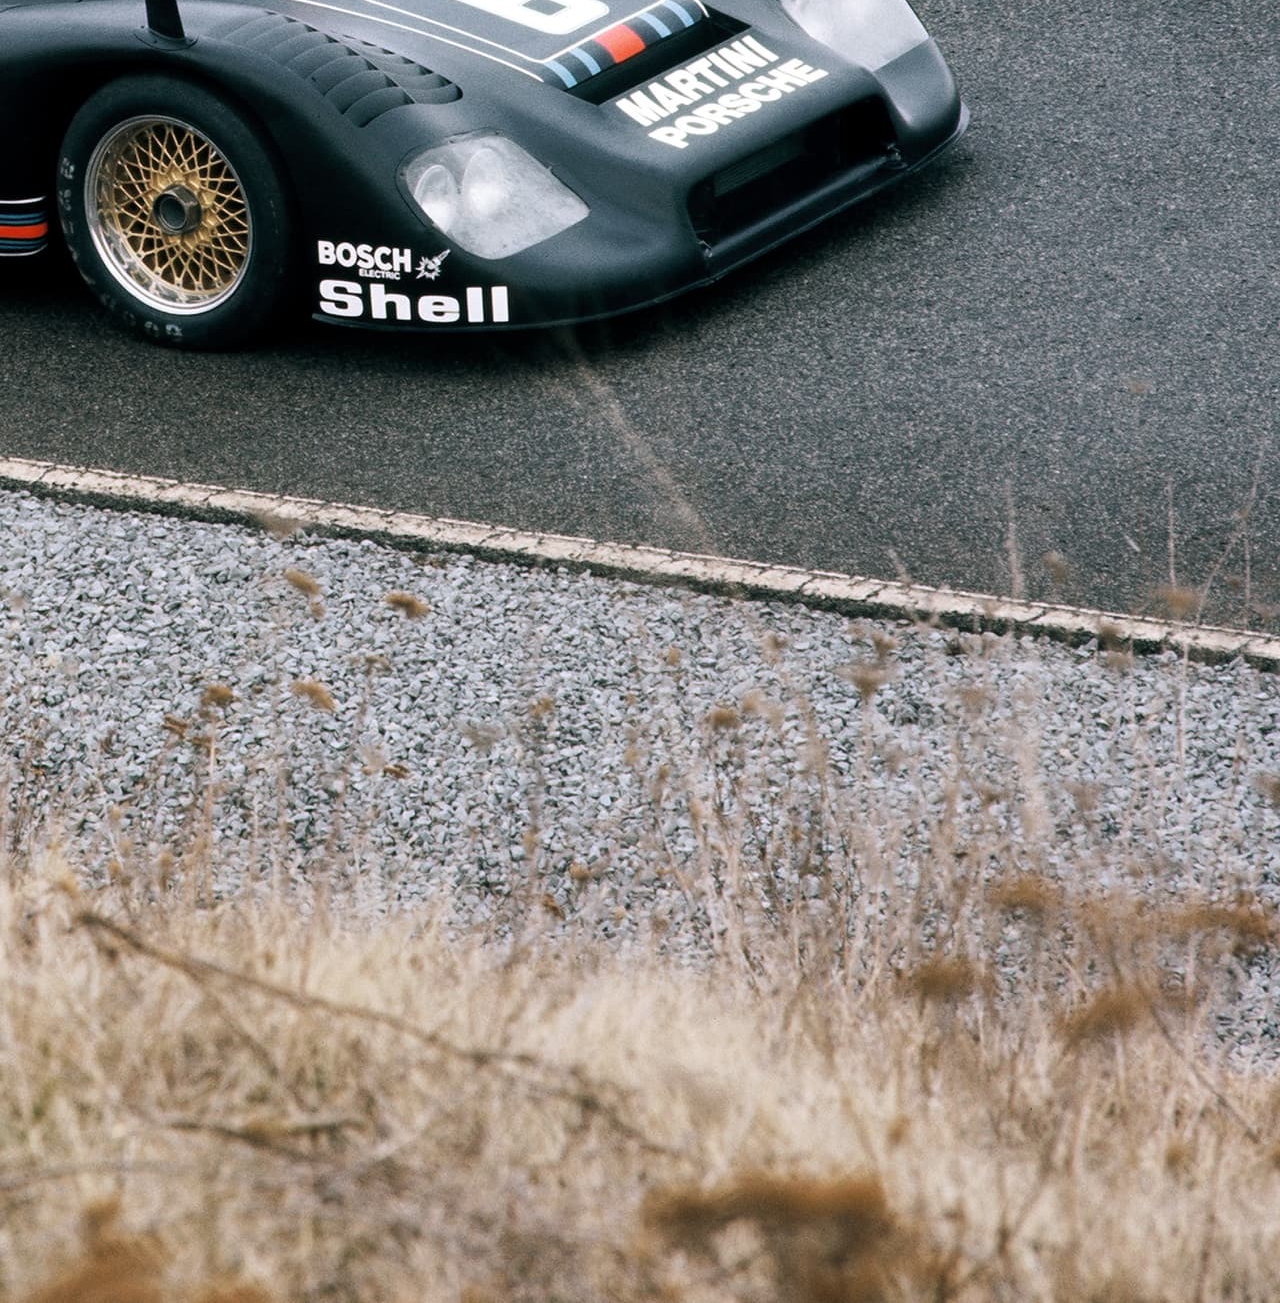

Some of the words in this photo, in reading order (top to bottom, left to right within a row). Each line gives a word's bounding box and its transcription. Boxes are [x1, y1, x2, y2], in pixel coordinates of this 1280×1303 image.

[616, 35, 780, 127] MARTINI
[648, 58, 829, 149] PORSCHE
[317, 240, 412, 273] BOSCH
[358, 268, 401, 281] ELECTRIC
[319, 279, 509, 323] Shell
